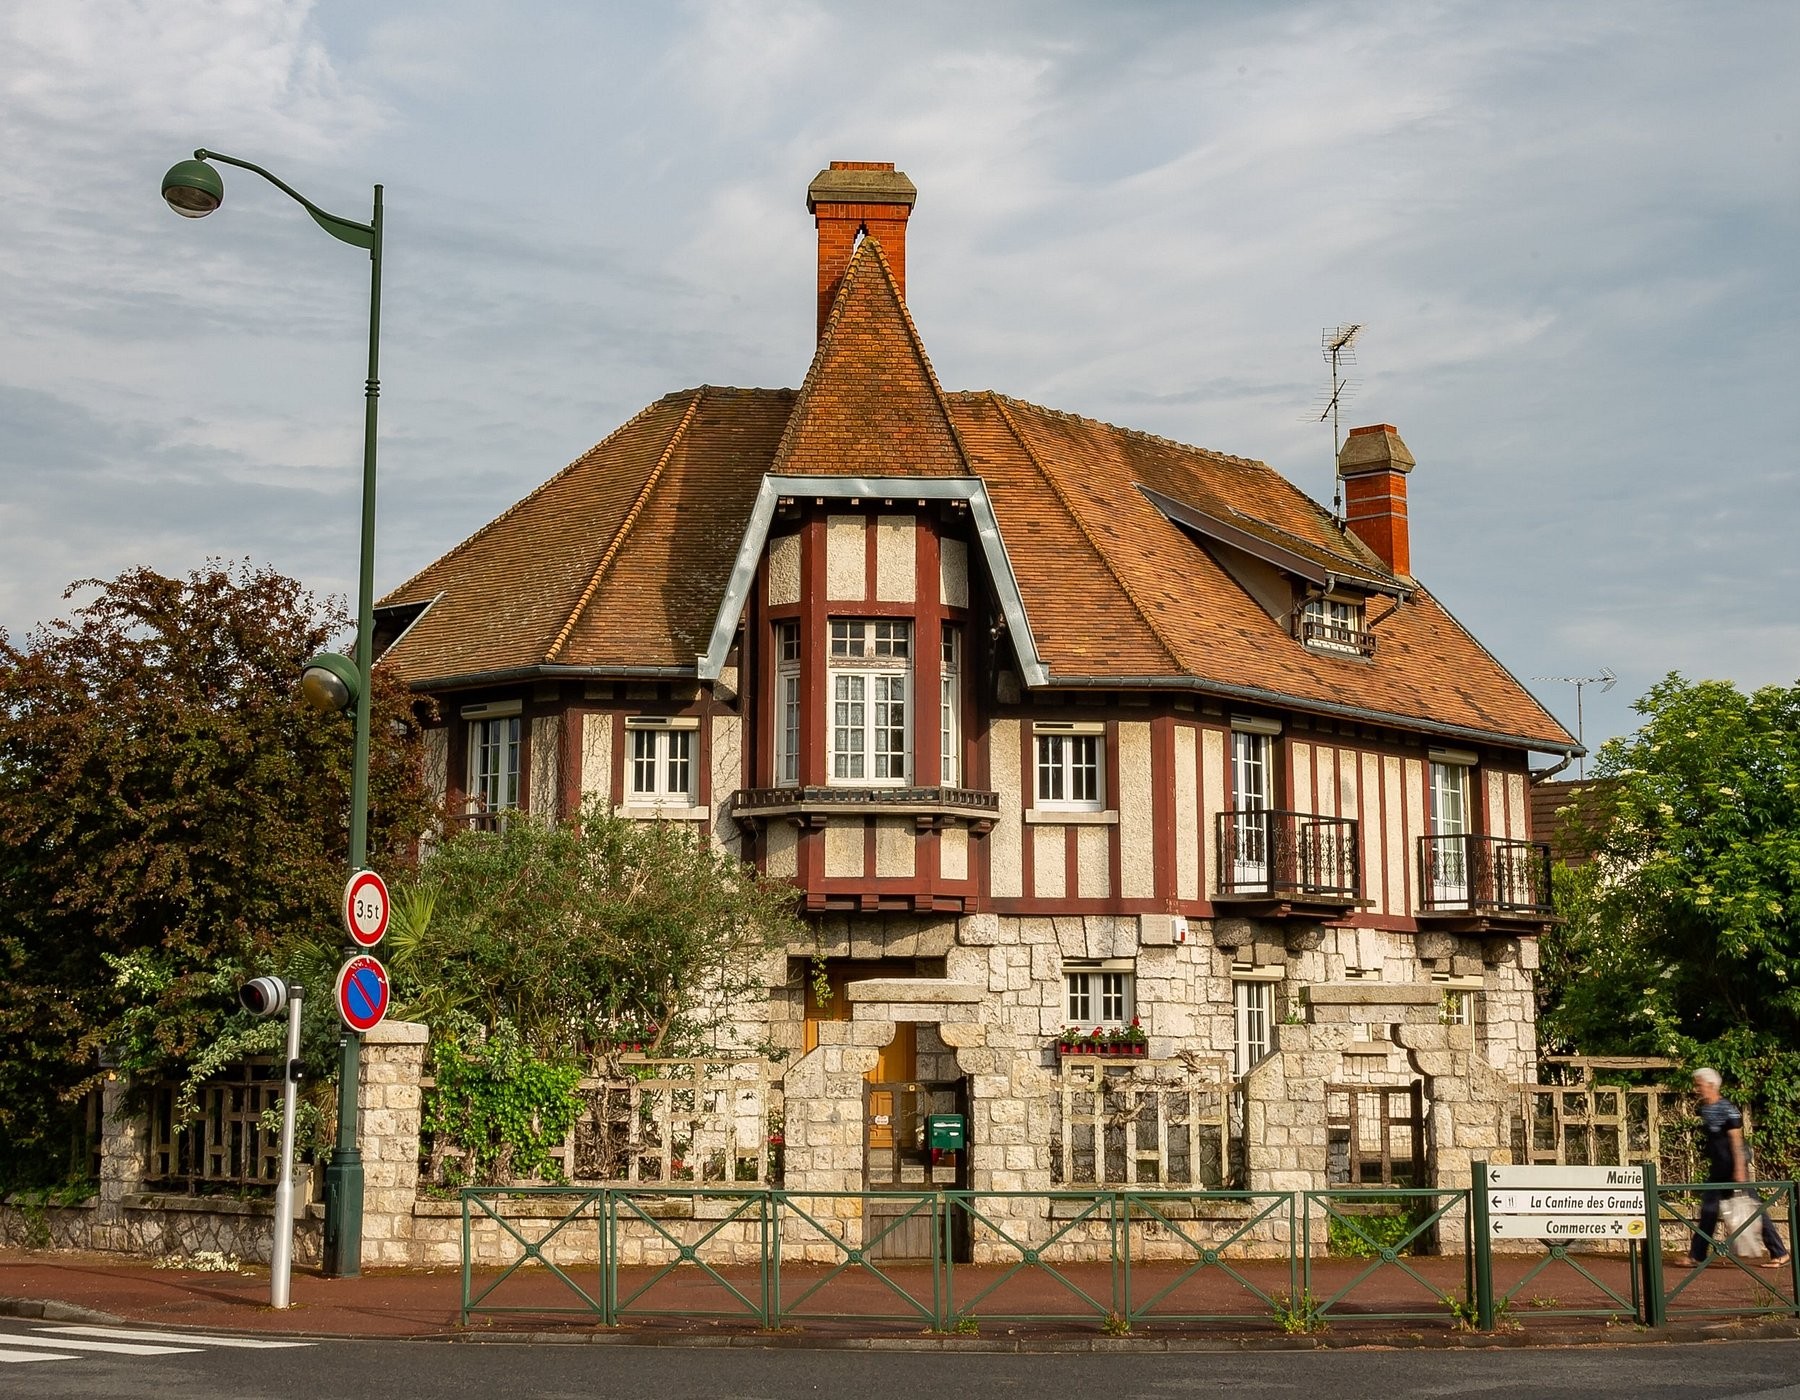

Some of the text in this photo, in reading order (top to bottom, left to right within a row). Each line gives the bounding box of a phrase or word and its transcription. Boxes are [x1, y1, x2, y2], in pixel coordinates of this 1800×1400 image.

[1606, 1170, 1642, 1184] Mairie
[1530, 1196, 1643, 1209] La Cantine des Grands
[1546, 1220, 1606, 1234] Commerces
